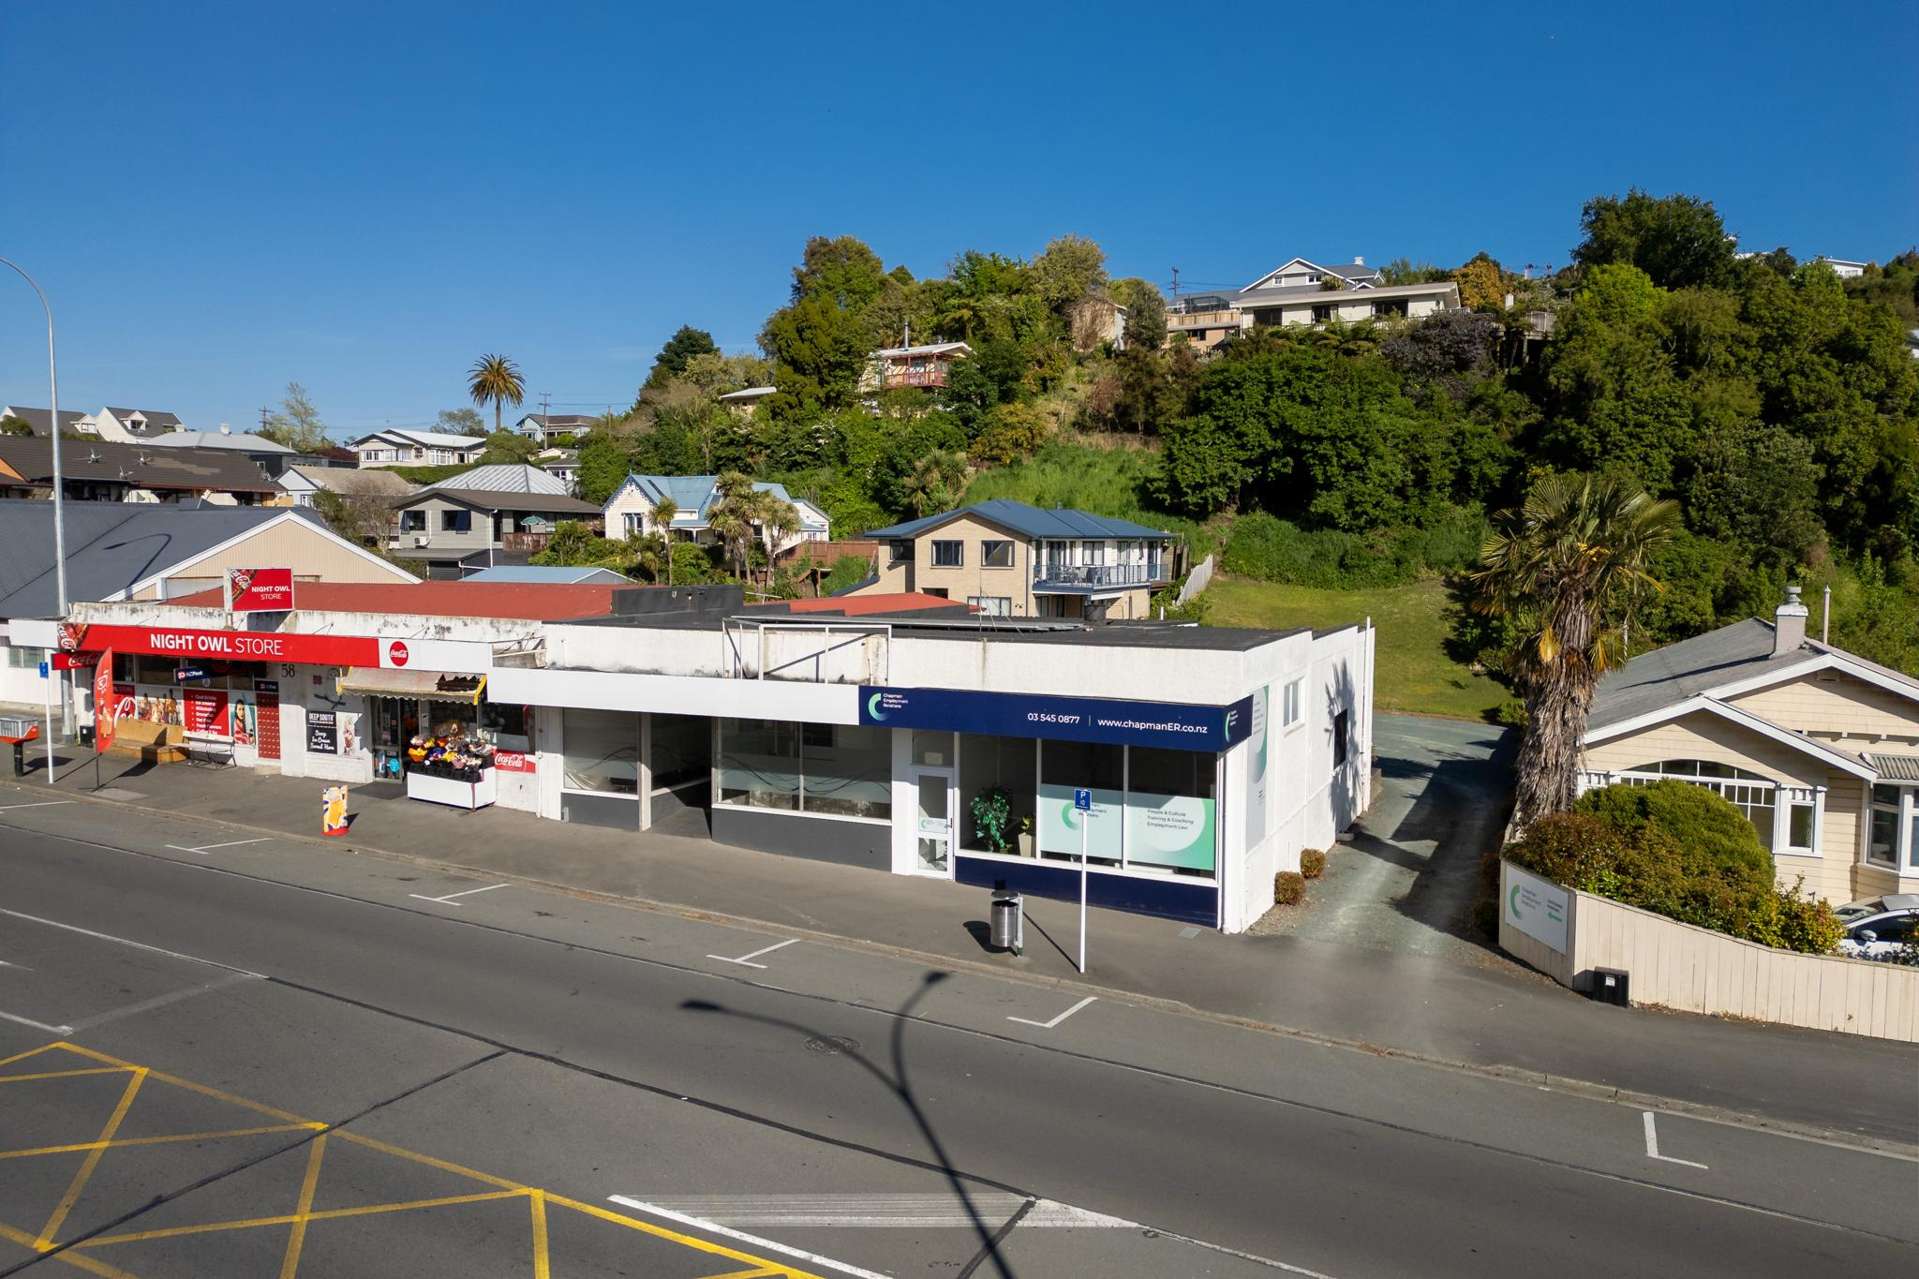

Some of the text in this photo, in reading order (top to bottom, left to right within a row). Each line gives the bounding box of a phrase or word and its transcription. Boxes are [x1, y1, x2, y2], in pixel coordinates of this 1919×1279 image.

[150, 633, 284, 655] NIGHT OWL STORE
[281, 664, 296, 678] 58
[1027, 712, 1080, 724] 03 545 0877
[1097, 718, 1208, 734] www.chapmanER.co.nz
[494, 752, 523, 768] Coca-Cola
[1080, 791, 1086, 799] P
[1147, 821, 1177, 829] Employment
